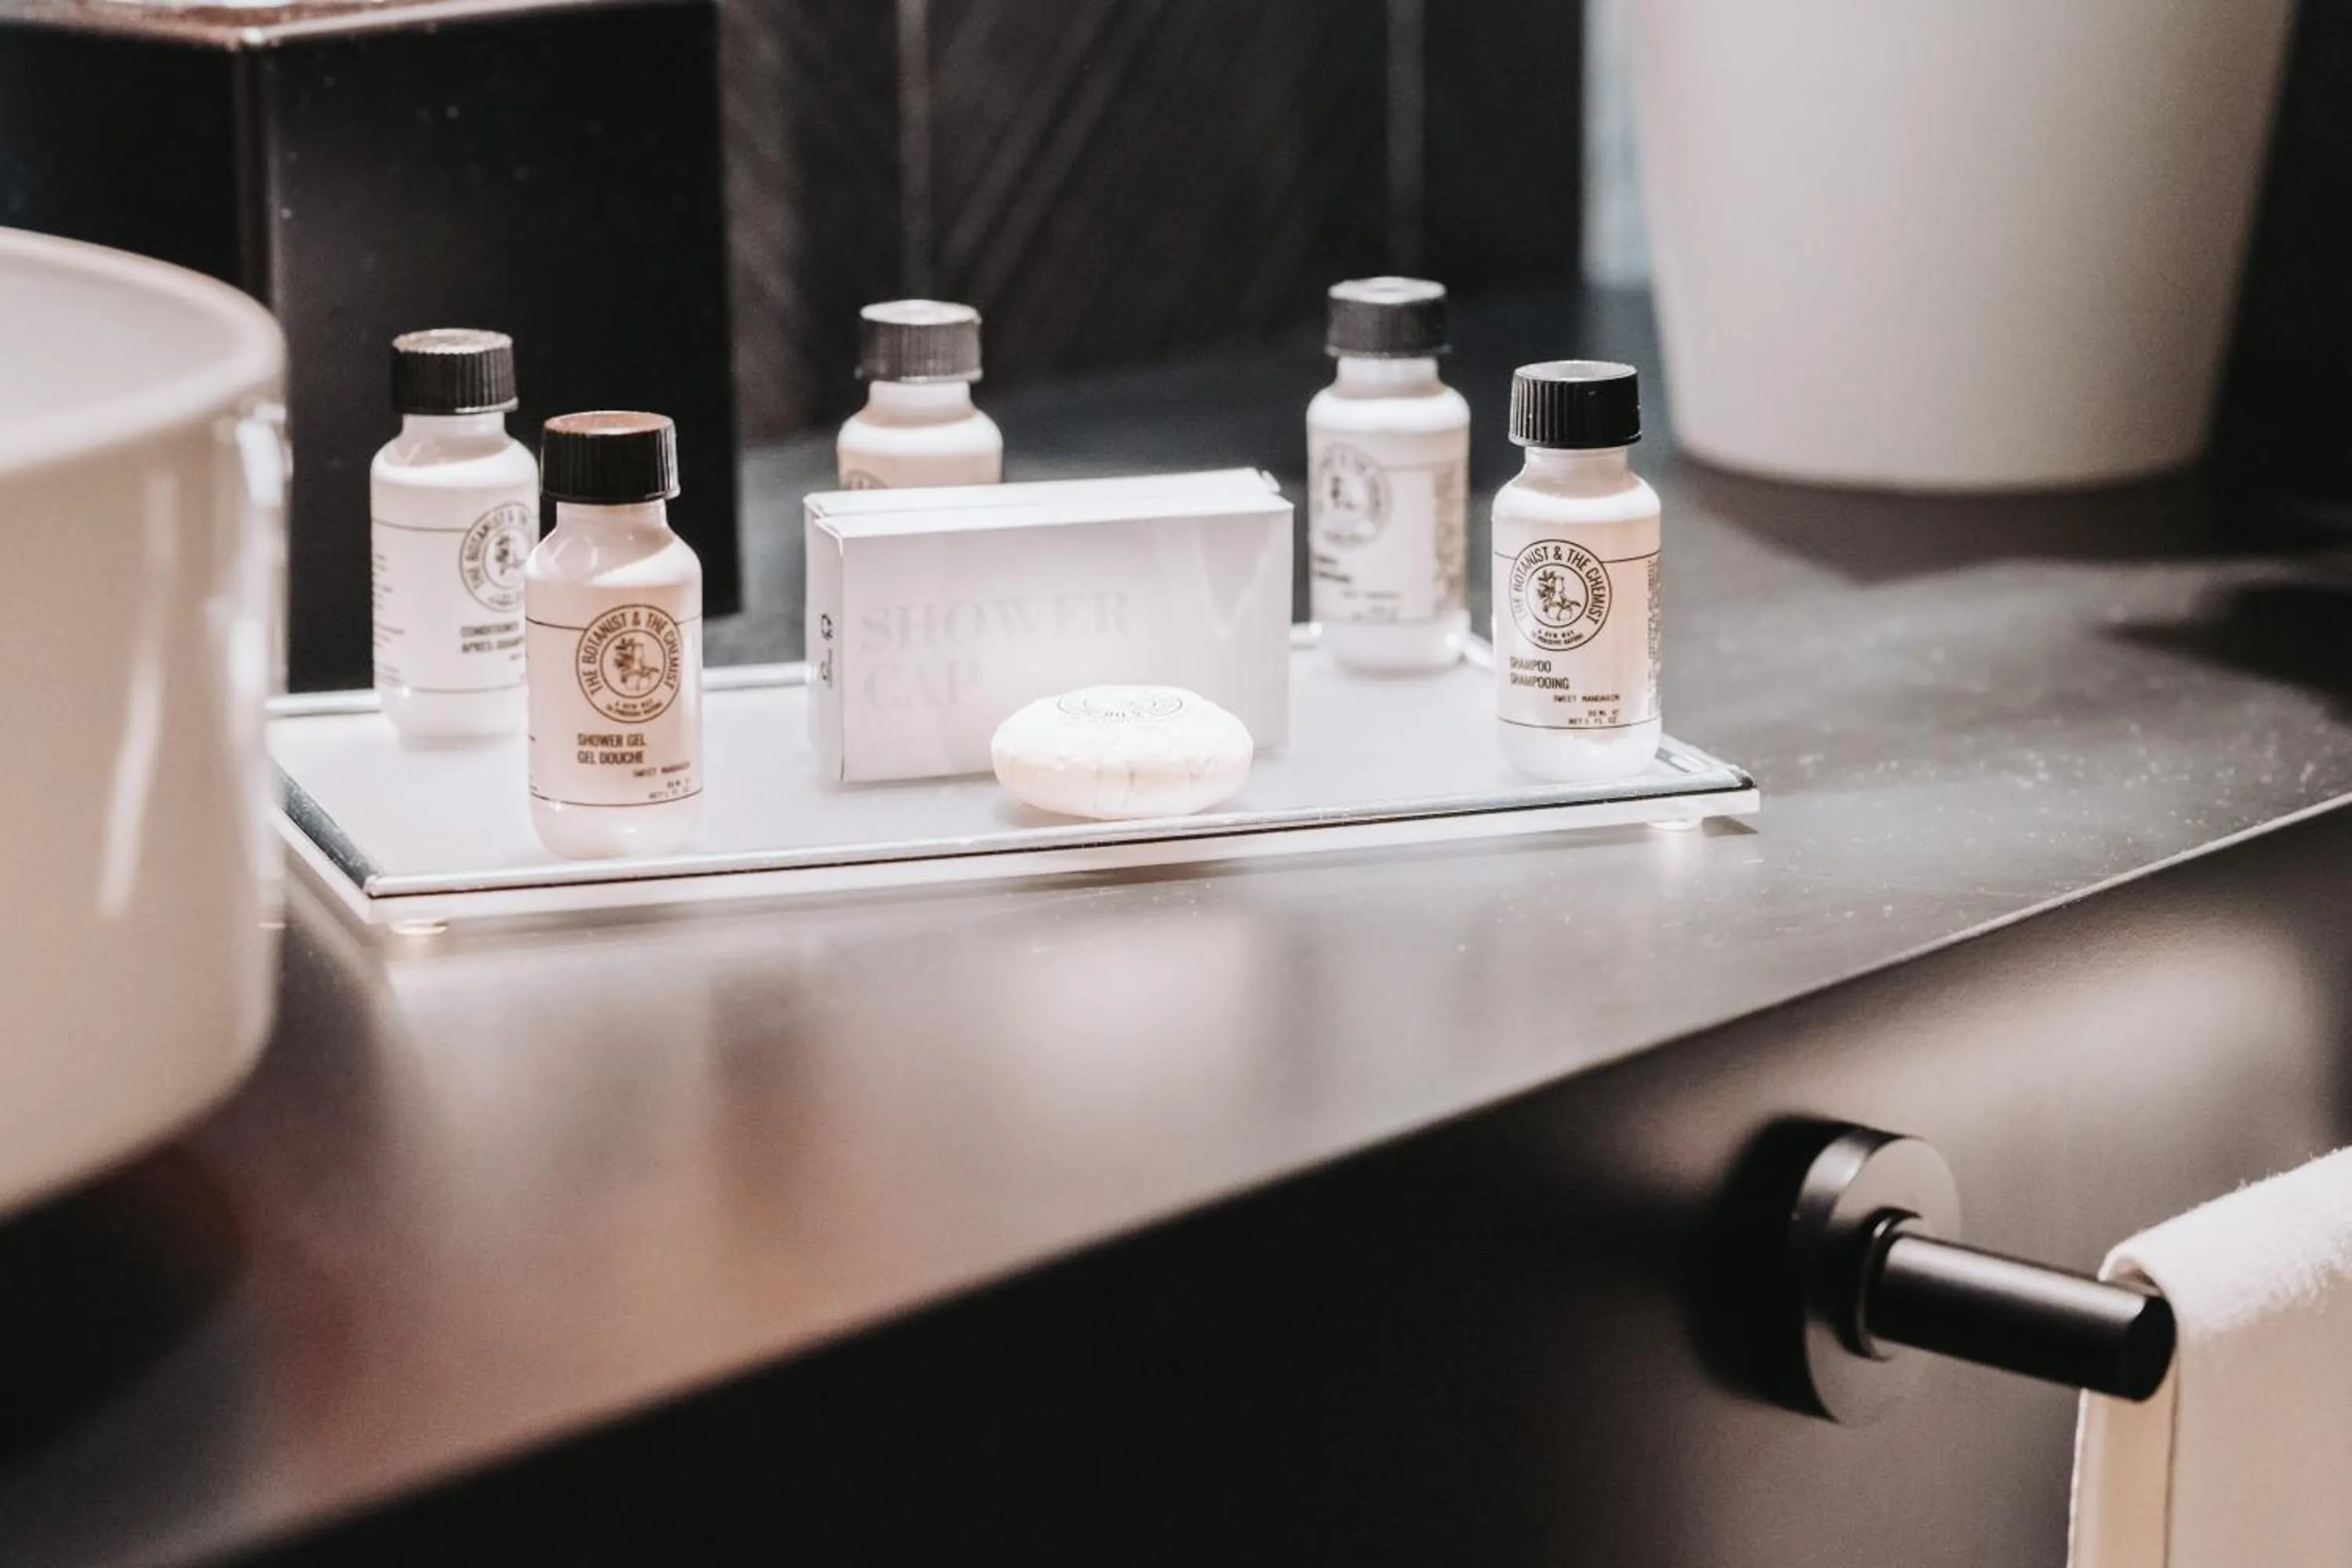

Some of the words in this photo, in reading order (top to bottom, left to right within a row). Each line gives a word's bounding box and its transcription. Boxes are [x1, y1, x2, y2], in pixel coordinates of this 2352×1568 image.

[1513, 546, 1549, 593] BOTANIST
[1553, 545, 1563, 561] &
[1566, 548, 1592, 574] THE
[1586, 567, 1606, 625] CHEMIST
[632, 611, 641, 627] &
[645, 612, 670, 636] THE
[860, 590, 1132, 653] SHOWER
[582, 612, 628, 665] BOTANIST
[1509, 655, 1552, 673] SHAMPOO
[582, 670, 604, 695] THE
[863, 659, 981, 711] CAP
[1509, 672, 1570, 690] SHAMPOOING
[577, 732, 624, 748] SHOWER
[626, 732, 648, 747] GEL
[577, 750, 597, 765] GEL
[599, 750, 645, 765] DOUCHE
